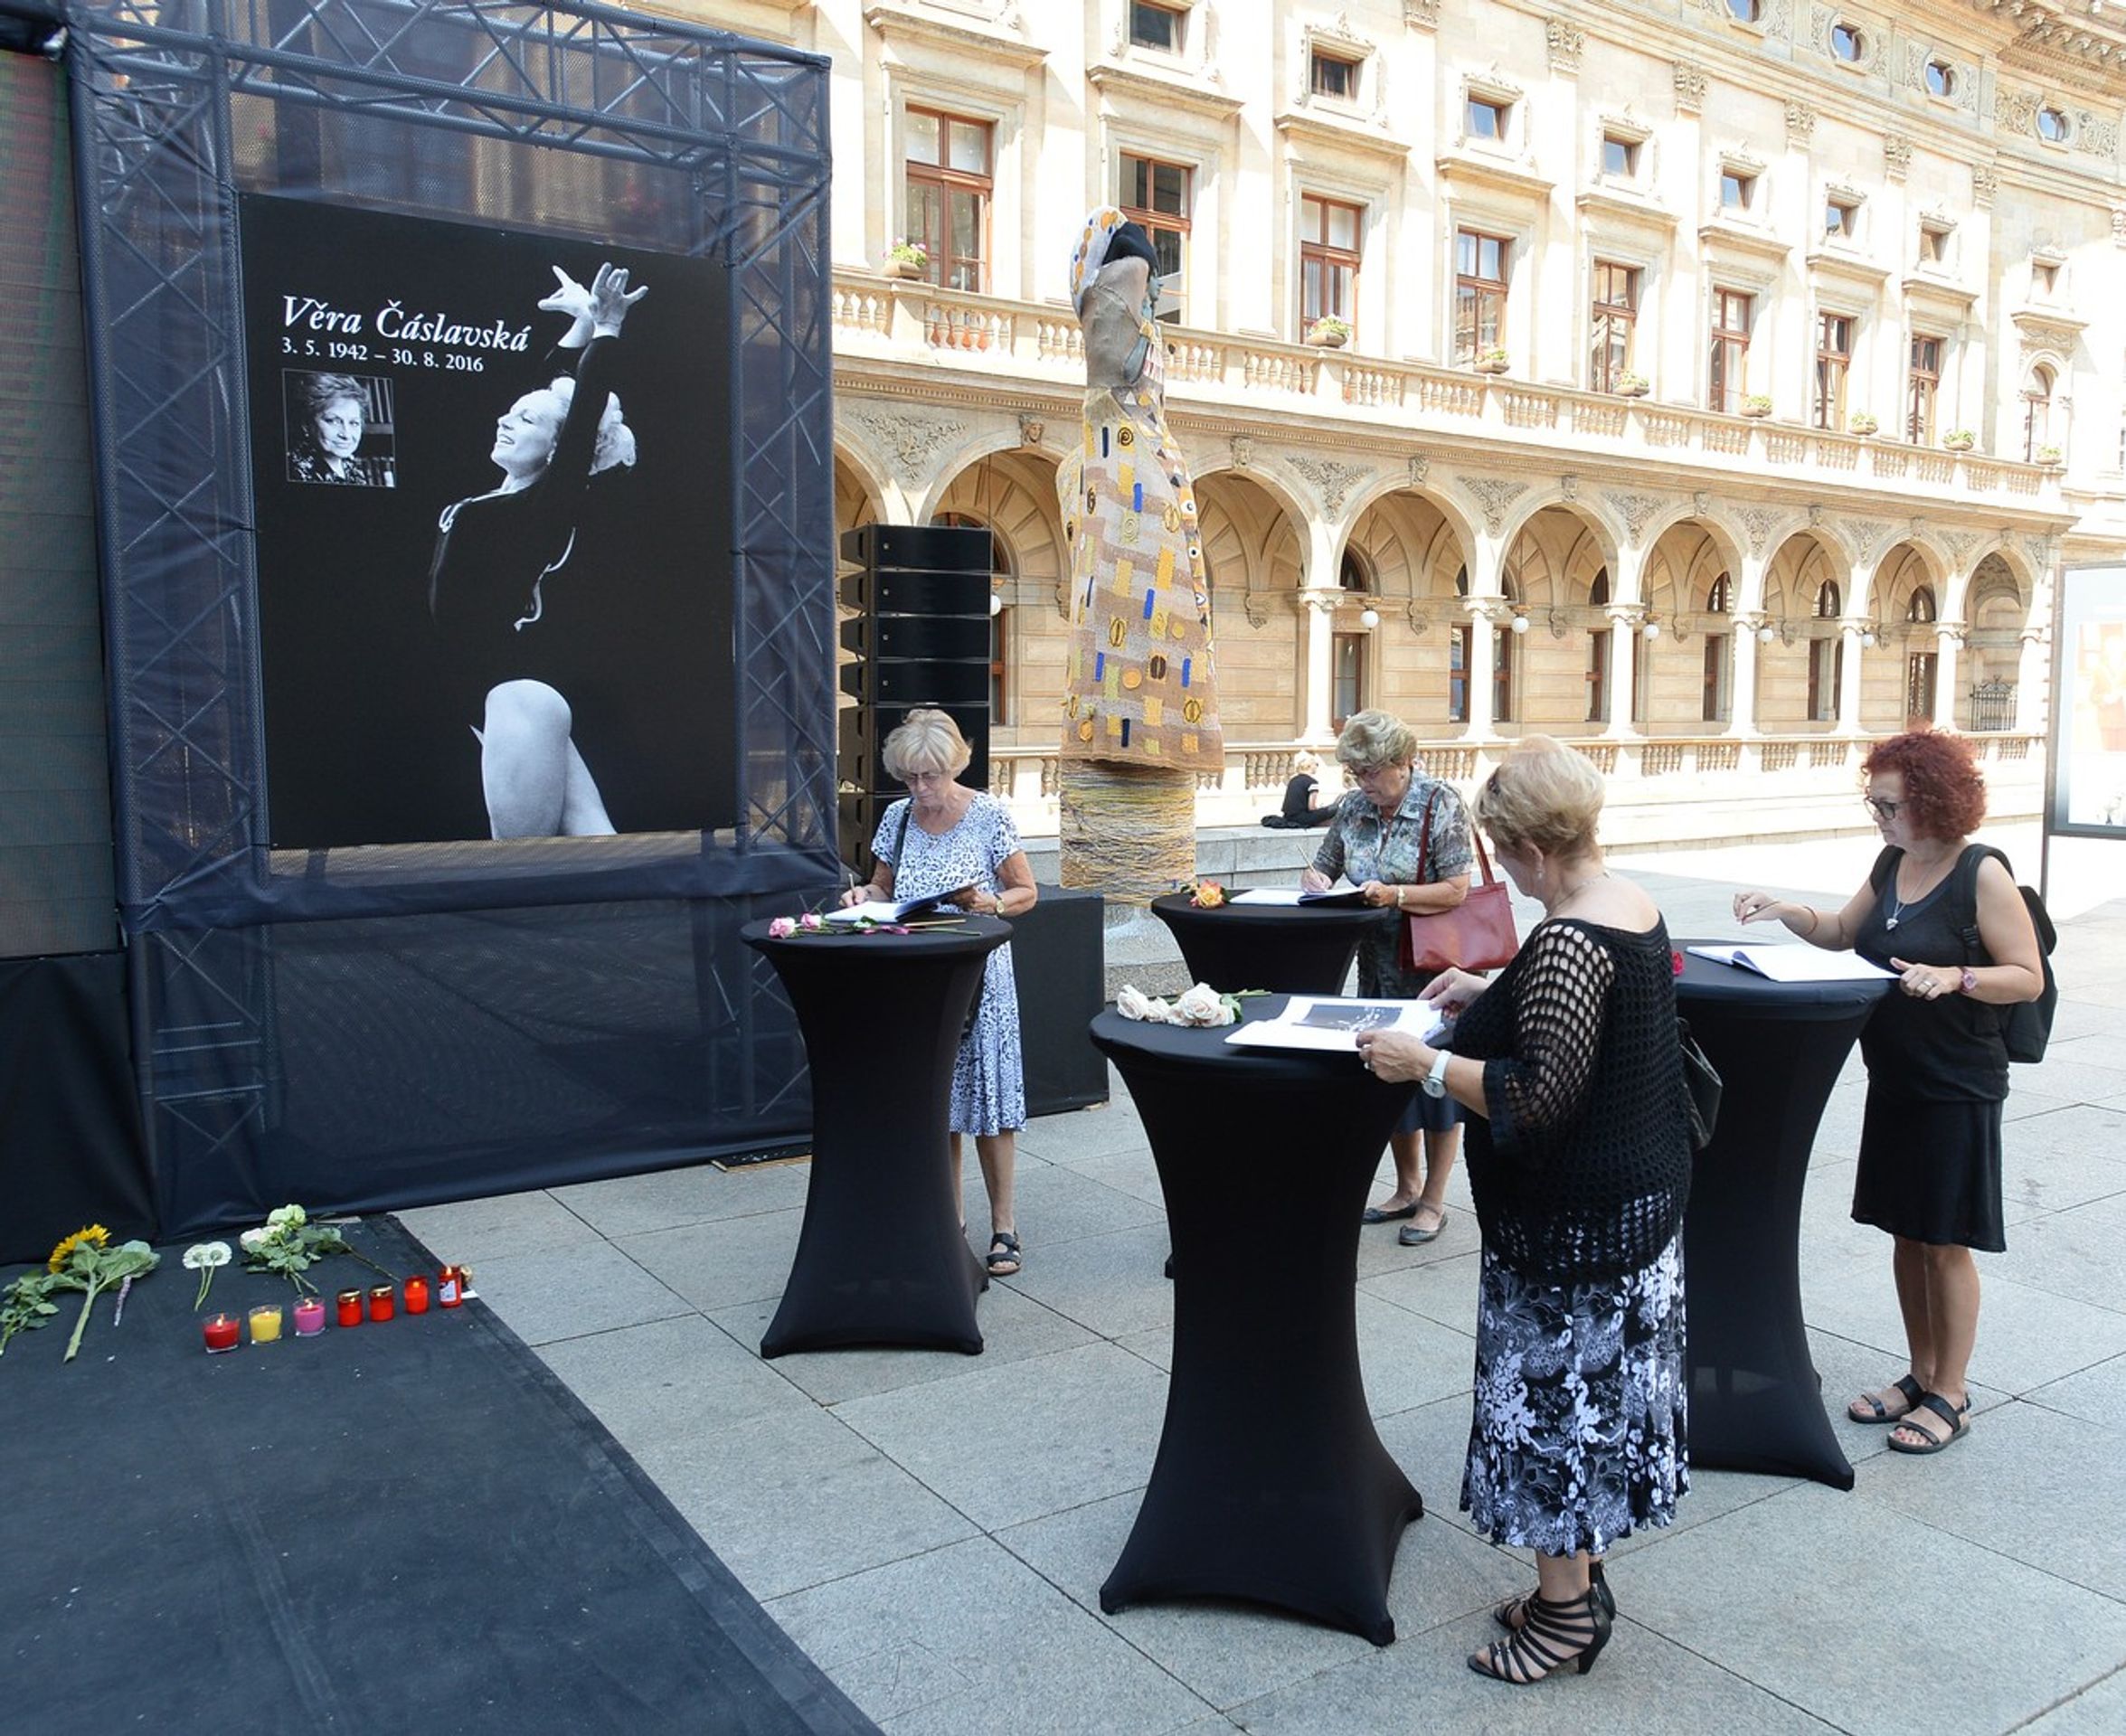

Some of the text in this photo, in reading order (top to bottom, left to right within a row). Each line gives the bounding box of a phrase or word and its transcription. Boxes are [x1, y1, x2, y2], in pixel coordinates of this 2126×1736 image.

[283, 295, 532, 352] Věra Čáslavská
[282, 337, 298, 354] 3.
[305, 340, 320, 356] 5.
[329, 342, 368, 361] 1942
[392, 349, 417, 365] 30.
[423, 352, 439, 368] 8.
[446, 354, 484, 372] 2016
